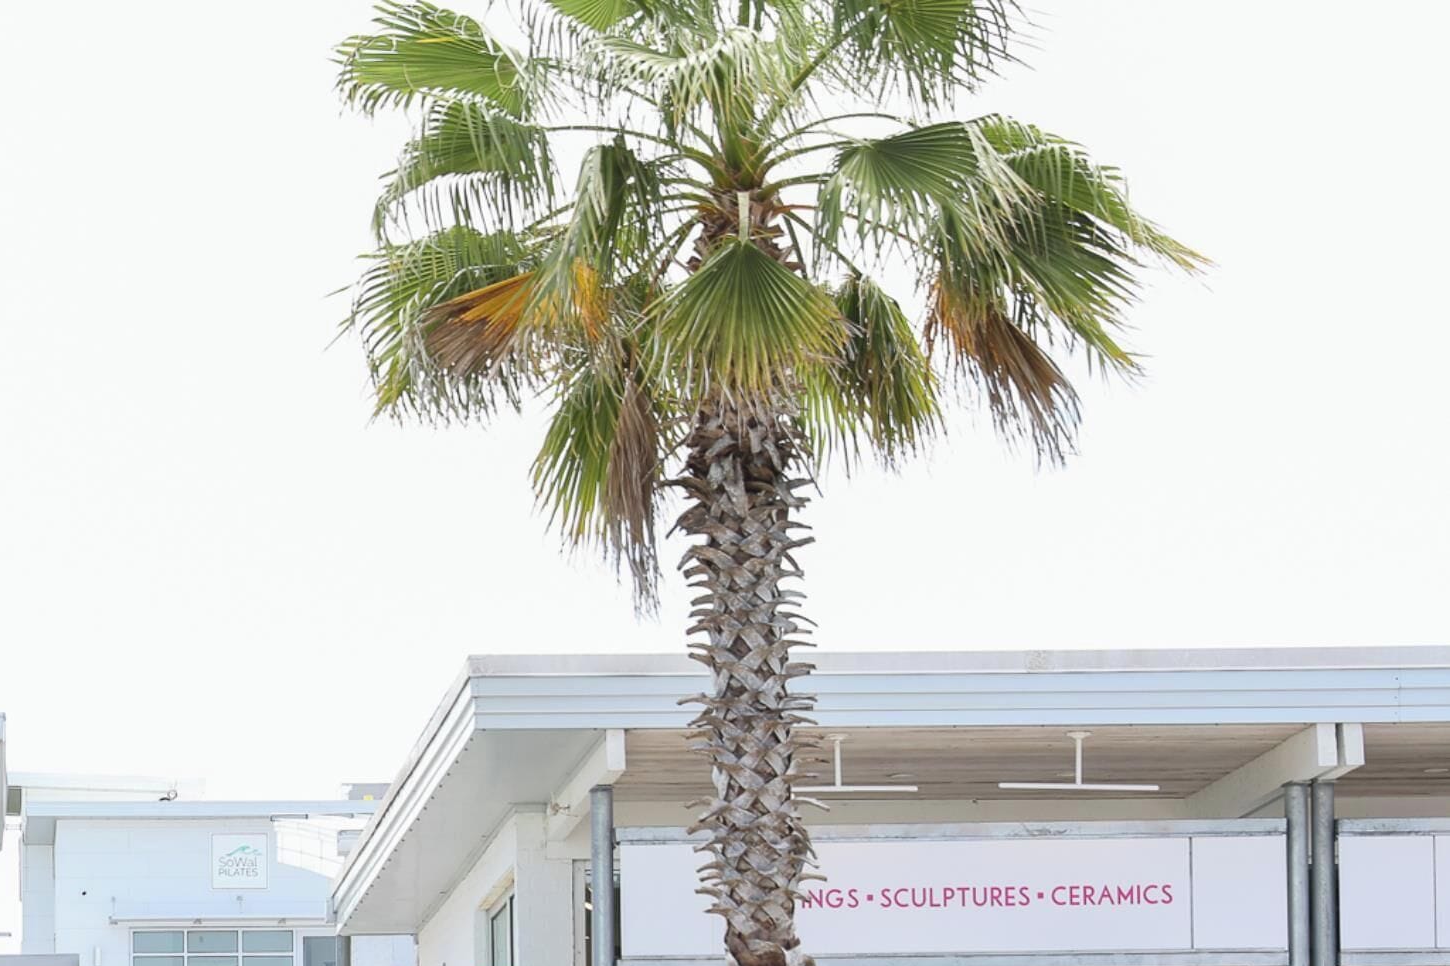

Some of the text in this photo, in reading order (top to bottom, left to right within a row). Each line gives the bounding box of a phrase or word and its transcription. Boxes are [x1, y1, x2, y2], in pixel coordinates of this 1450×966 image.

[218, 856, 258, 868] SoWal
[218, 867, 259, 877] PILATES
[880, 886, 1030, 908] SCULPTURES
[1051, 884, 1173, 906] CERAMICS
